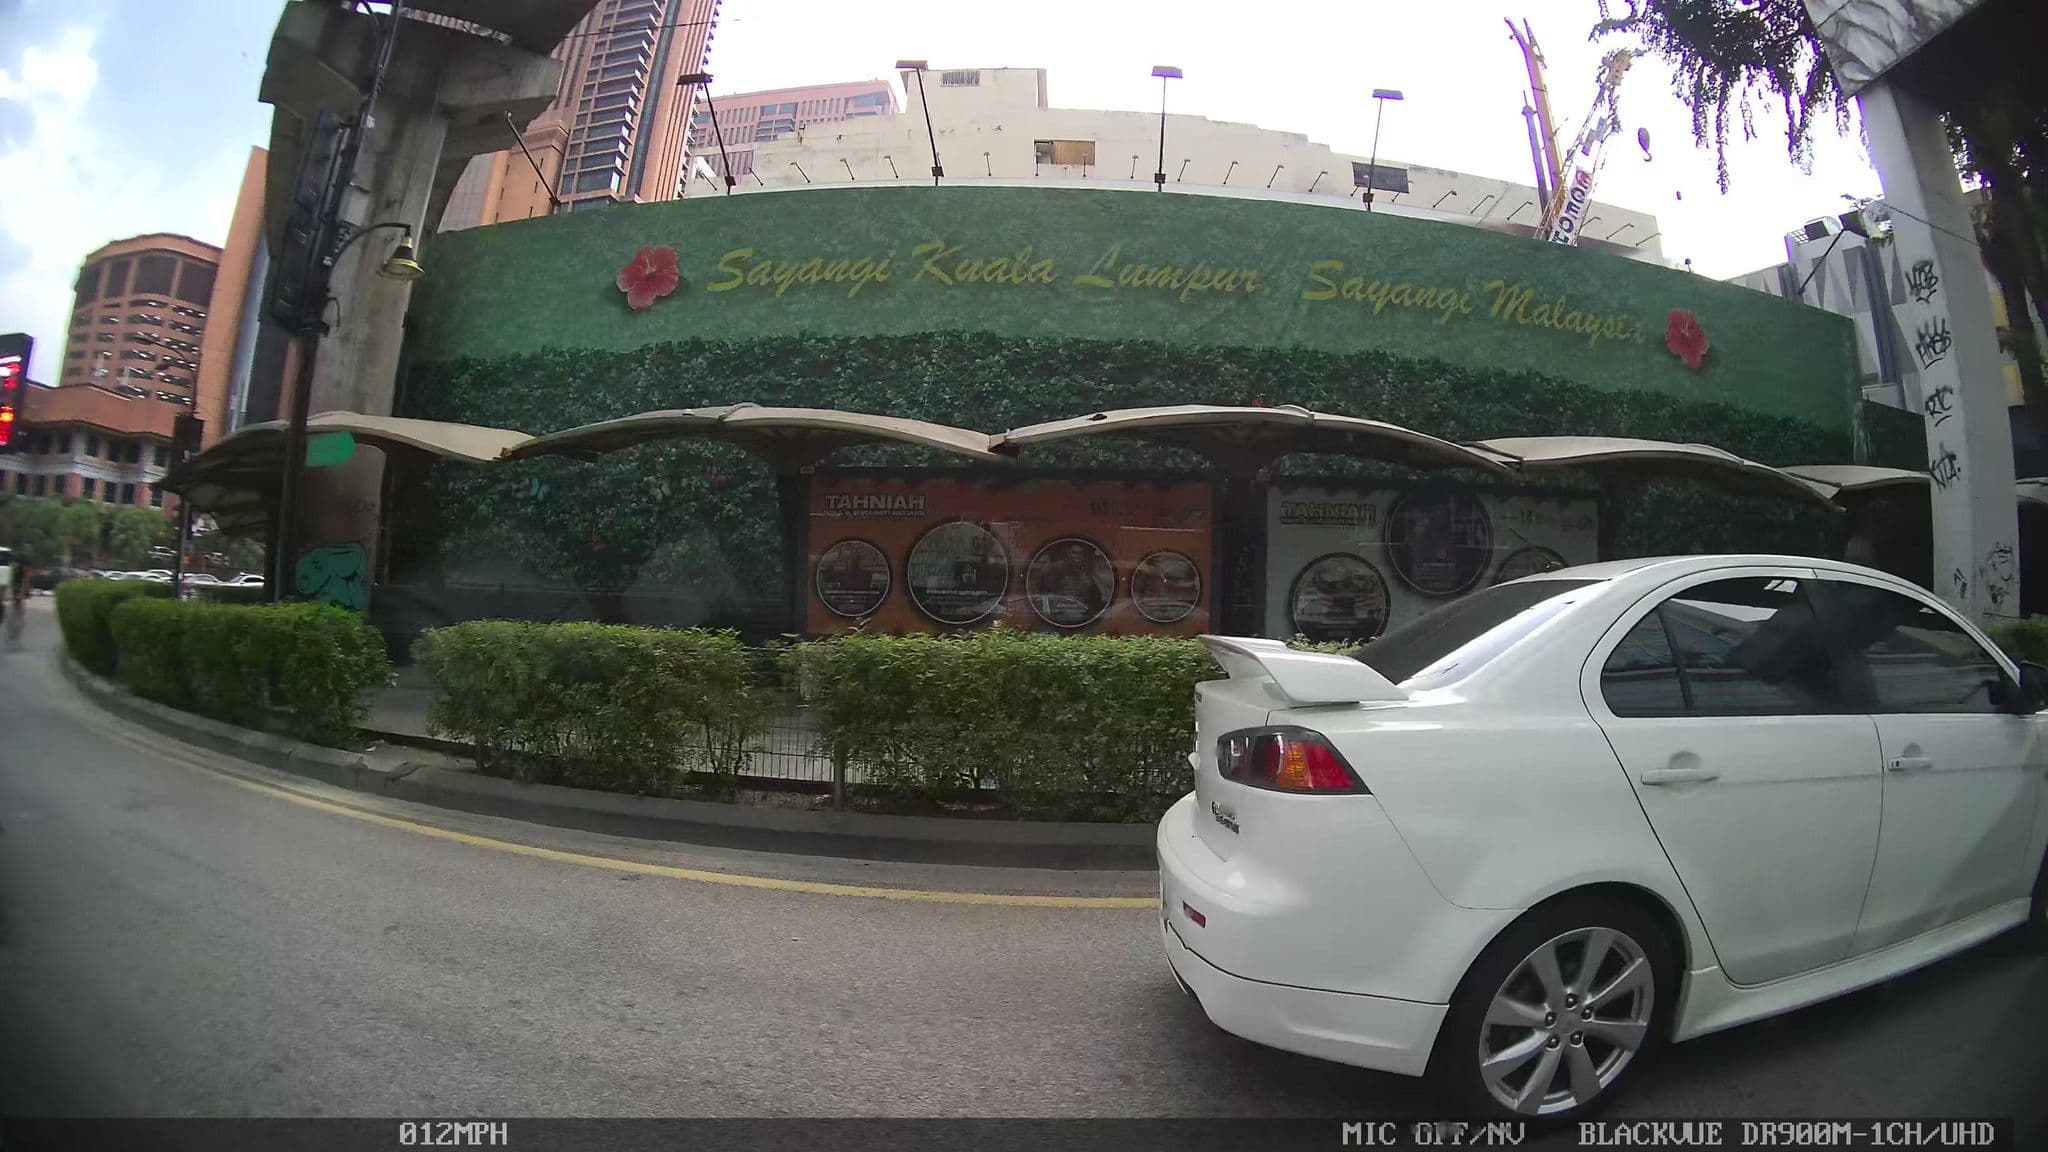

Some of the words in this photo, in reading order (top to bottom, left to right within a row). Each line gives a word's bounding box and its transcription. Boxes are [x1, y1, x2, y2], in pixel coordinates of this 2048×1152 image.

[707, 248, 895, 298] Sayangi
[912, 241, 1059, 285] Kuala
[1074, 245, 1262, 302] Lumpur
[1303, 260, 1472, 325] Sayangi
[1485, 280, 1646, 348] Malaysia
[826, 494, 927, 510] TAHNIAH
